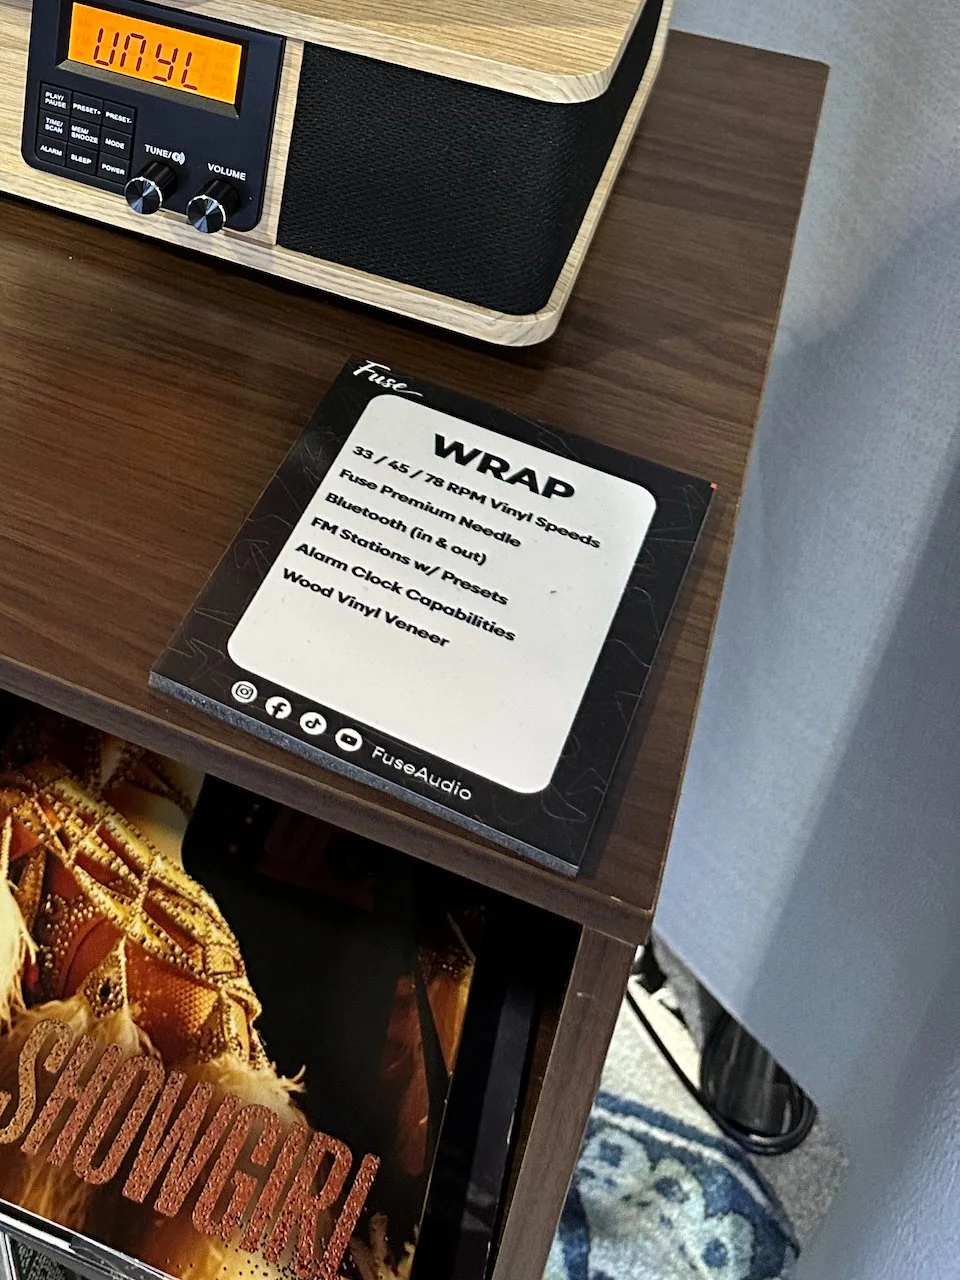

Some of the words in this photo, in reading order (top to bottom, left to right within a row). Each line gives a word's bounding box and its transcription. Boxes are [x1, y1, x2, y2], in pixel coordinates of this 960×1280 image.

[45, 98, 66, 109] PAUSE
[45, 124, 63, 134] SCAN
[71, 132, 98, 144] SNOOZE
[105, 138, 125, 149] MODE
[40, 145, 62, 156] ALARM
[71, 154, 92, 164] SLEEP
[101, 163, 125, 175] POWER
[207, 162, 247, 181] VOLUME
[353, 359, 424, 398] Fuse
[433, 433, 576, 499] WRAP
[339, 468, 378, 490] Fuse
[380, 485, 457, 521] Premium
[459, 515, 522, 548] Needle
[352, 446, 375, 460] 33
[388, 460, 410, 474] 45
[425, 473, 445, 488] 78
[446, 482, 487, 505] RPM
[490, 498, 534, 522] Vinyl
[536, 517, 602, 549] Speeds
[325, 492, 407, 533] Bluetooth
[409, 526, 433, 543] (in
[435, 538, 448, 549] &
[451, 544, 488, 566] out)
[311, 516, 339, 535] FM
[339, 528, 411, 565] Stations
[414, 560, 440, 576] w/
[441, 570, 509, 605] Presets
[283, 568, 335, 597] Wood
[338, 591, 382, 618] Vinyl
[385, 611, 451, 647] Veneer
[295, 543, 348, 571] Alarm
[351, 566, 403, 595] Clock
[405, 589, 517, 641] Capabilities
[371, 746, 473, 801] FuseAudio
